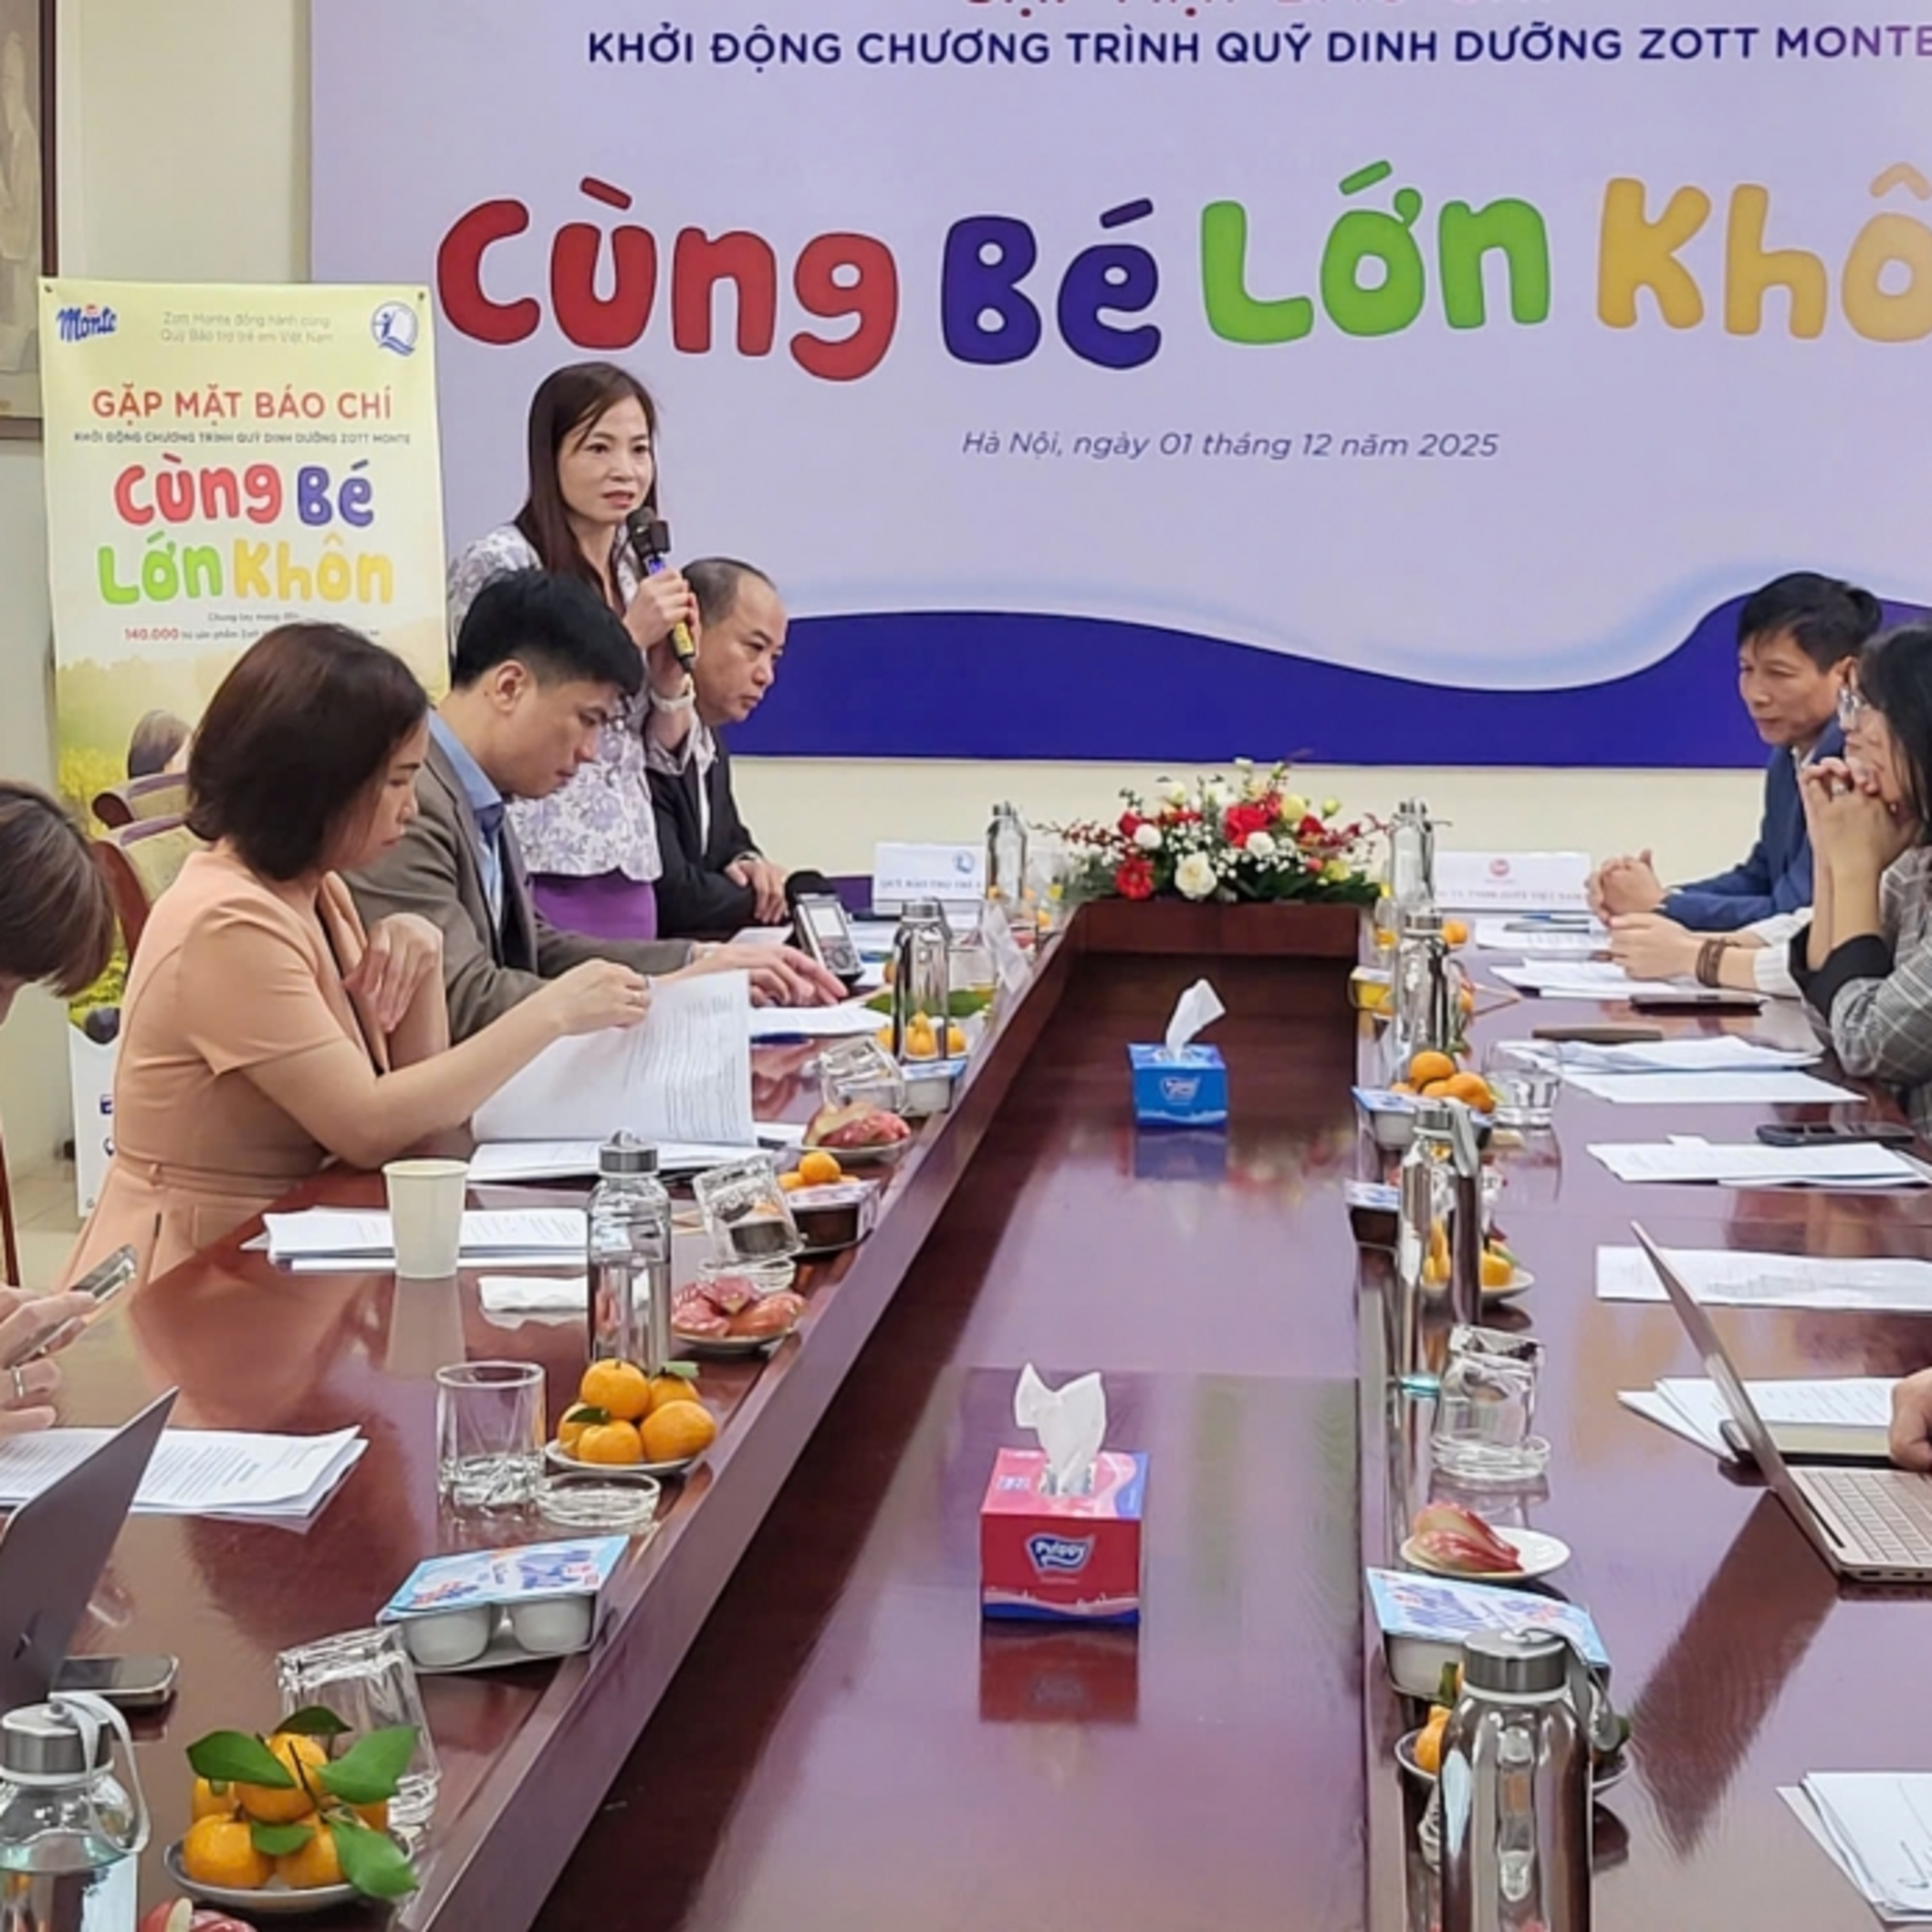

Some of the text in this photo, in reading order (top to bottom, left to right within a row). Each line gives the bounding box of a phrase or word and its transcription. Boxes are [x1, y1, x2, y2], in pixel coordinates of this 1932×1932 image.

[589, 21, 1932, 72] KHỞI ĐỘNG CHƯƠNG TRÌNH QUỸ DINH DƯỠNG ZOTT MONTE
[438, 177, 898, 381] Cùng
[942, 198, 1162, 370] Bé
[1201, 160, 1551, 345] Lớn
[92, 383, 391, 426] GẶP MẶT BÁO CHÍ
[962, 432, 1499, 460] Hà Nội, ngày 01 tháng 12 năm 2025
[115, 453, 374, 527] Cùng Bé
[98, 530, 393, 604] Lớn Khôn
[125, 629, 178, 639] 140.000
